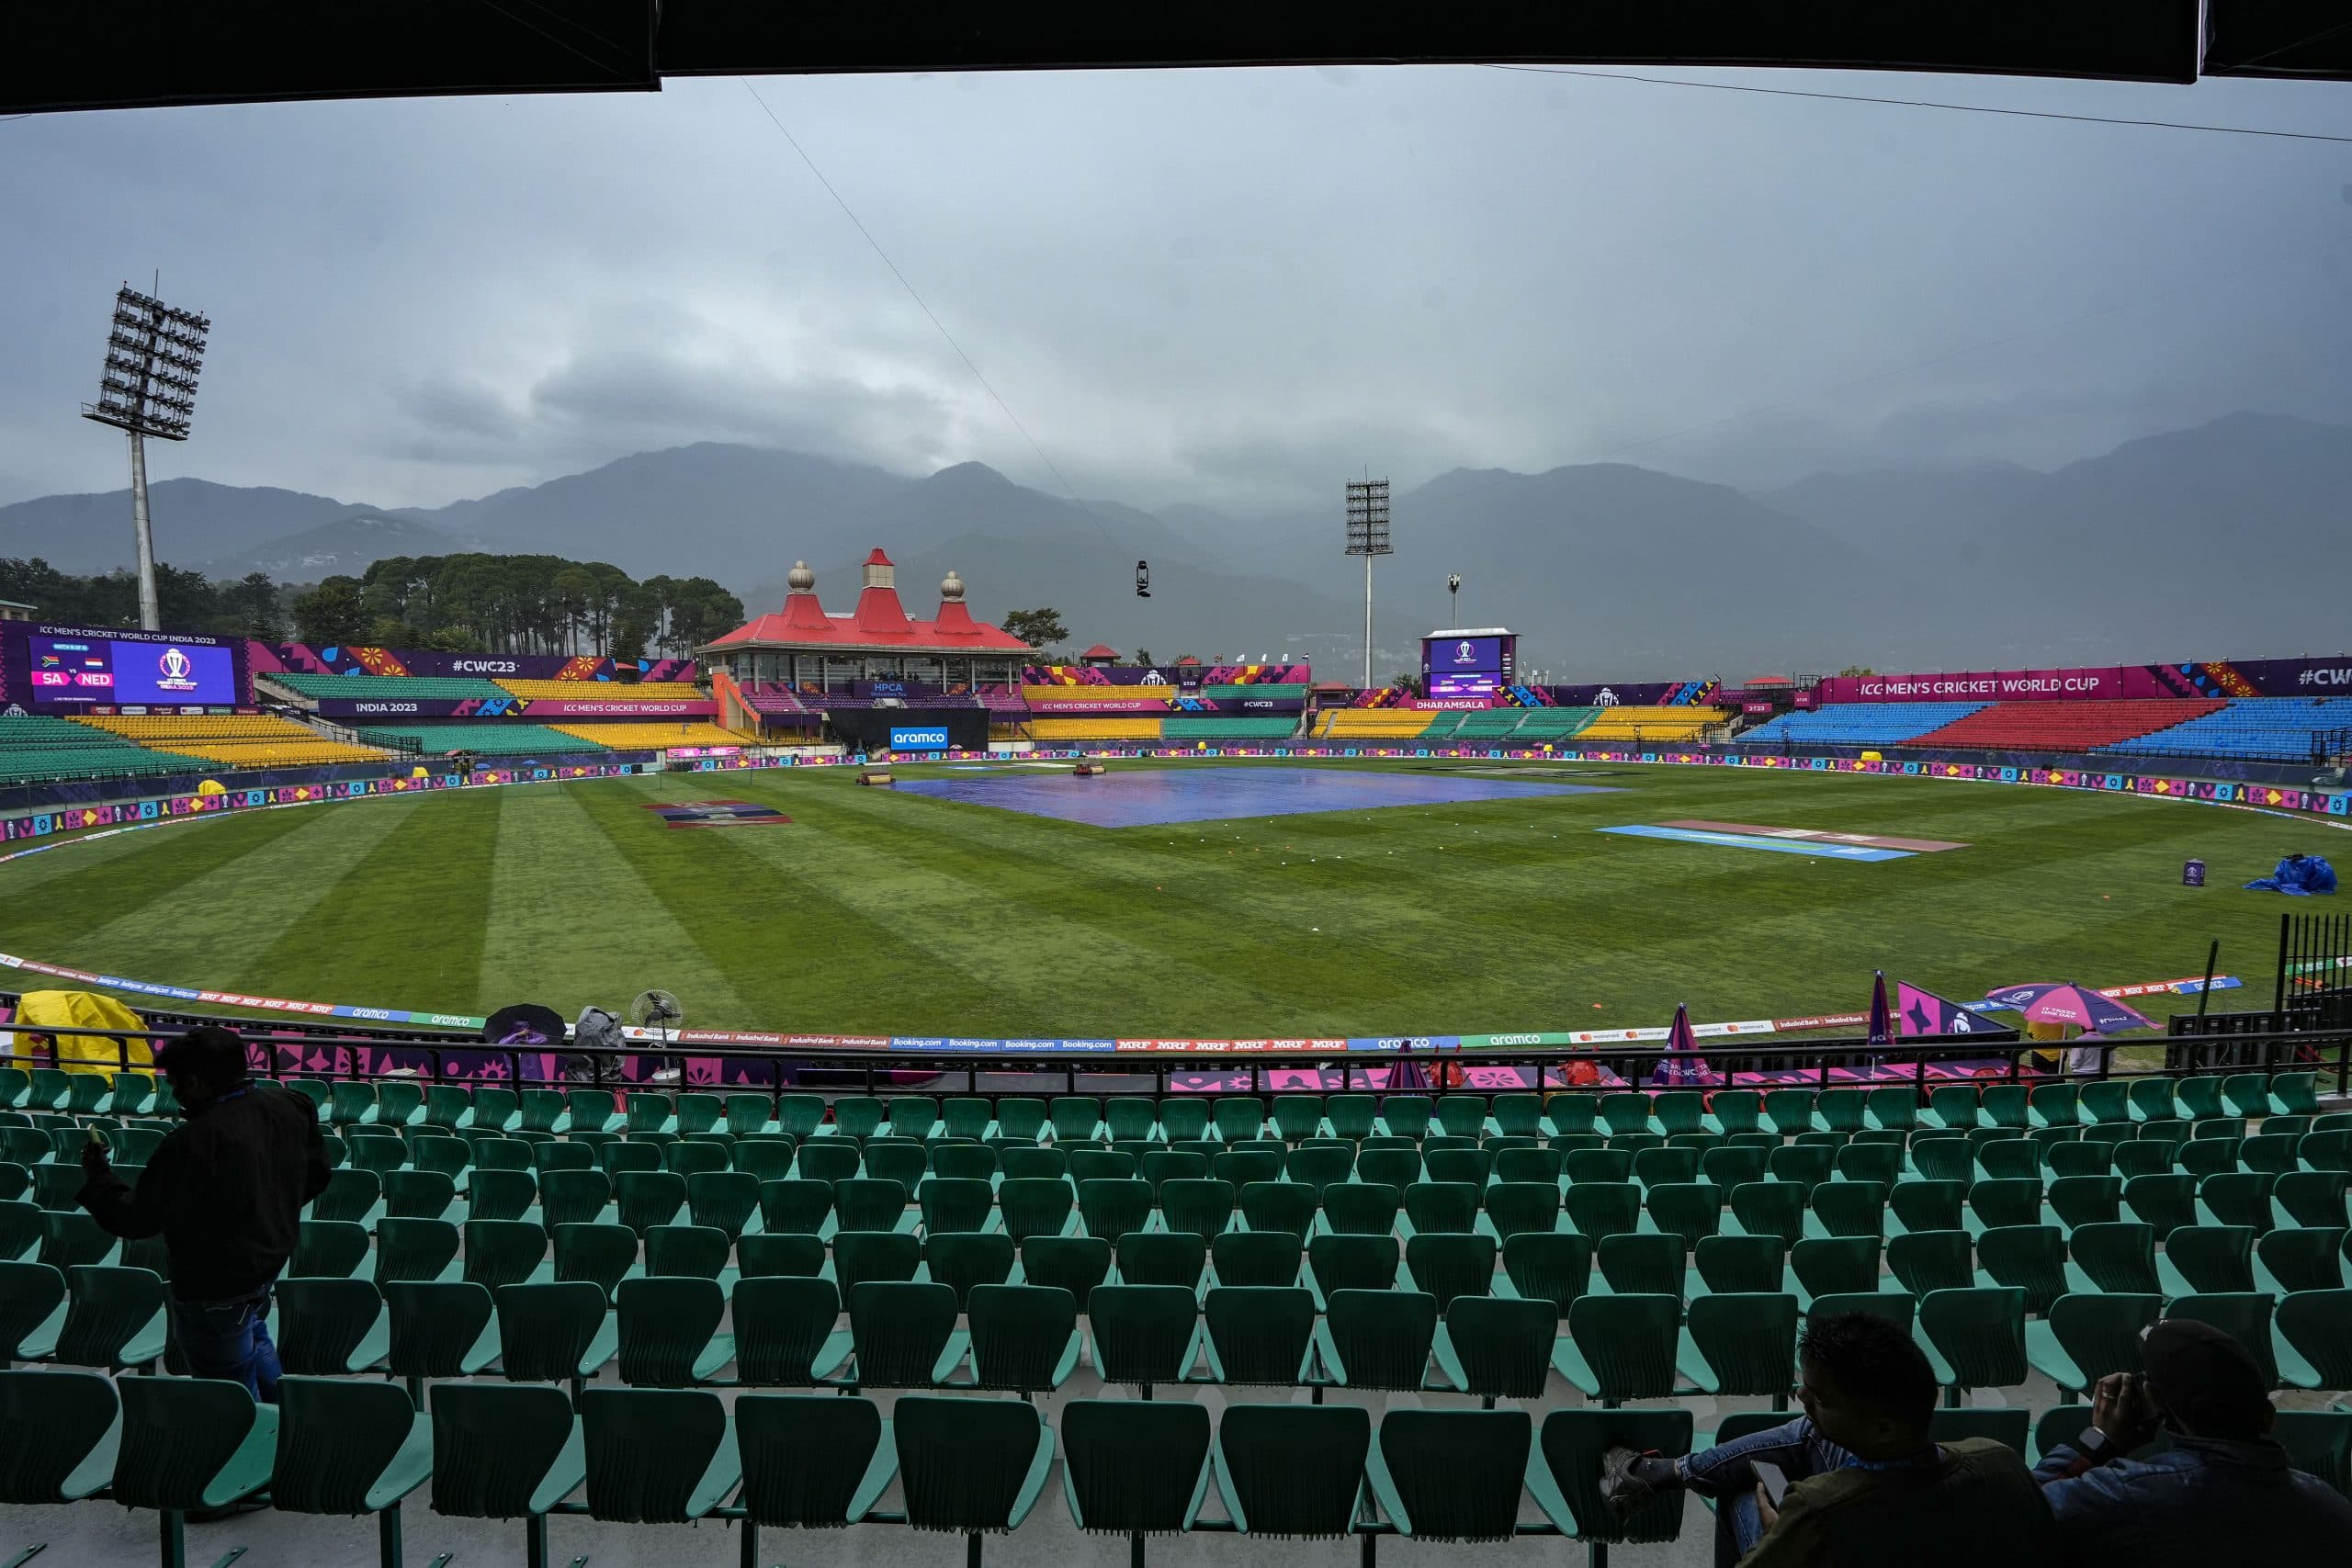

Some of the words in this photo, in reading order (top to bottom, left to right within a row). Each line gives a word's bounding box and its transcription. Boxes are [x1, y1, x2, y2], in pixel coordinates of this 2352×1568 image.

[40, 626, 53, 634] ICC
[54, 627, 81, 636] MEN'S
[82, 629, 118, 638] CRICKET
[119, 632, 151, 640] WORLD
[452, 660, 516, 672] #CWC23
[42, 672, 62, 684] SA
[82, 674, 110, 685] NED
[2299, 669, 2352, 685] #CW
[874, 683, 903, 692] HPCA
[1860, 683, 1883, 695] ICC
[1885, 682, 1930, 694] MEN'S
[1933, 680, 1998, 694] CRICKET
[2002, 679, 2062, 693] WORLD
[2064, 678, 2100, 691] CUP
[356, 704, 388, 712] INDIA
[390, 703, 417, 711] 2023
[894, 733, 944, 743] aramco
[353, 1008, 390, 1020] aramco
[431, 1014, 470, 1026] aramco
[893, 1038, 941, 1047] Booking.com
[949, 1039, 997, 1047] Booking.com
[1005, 1040, 1055, 1049] Booking.com
[1062, 1040, 1112, 1049] Booking.com
[1490, 1034, 1540, 1045] aramco
[1117, 1041, 1151, 1050] MRF
[1157, 1042, 1191, 1050] MRF
[1195, 1042, 1229, 1051] MRF
[1234, 1041, 1267, 1049] MRF
[1272, 1040, 1306, 1049] MRF
[1311, 1040, 1344, 1049] MRF
